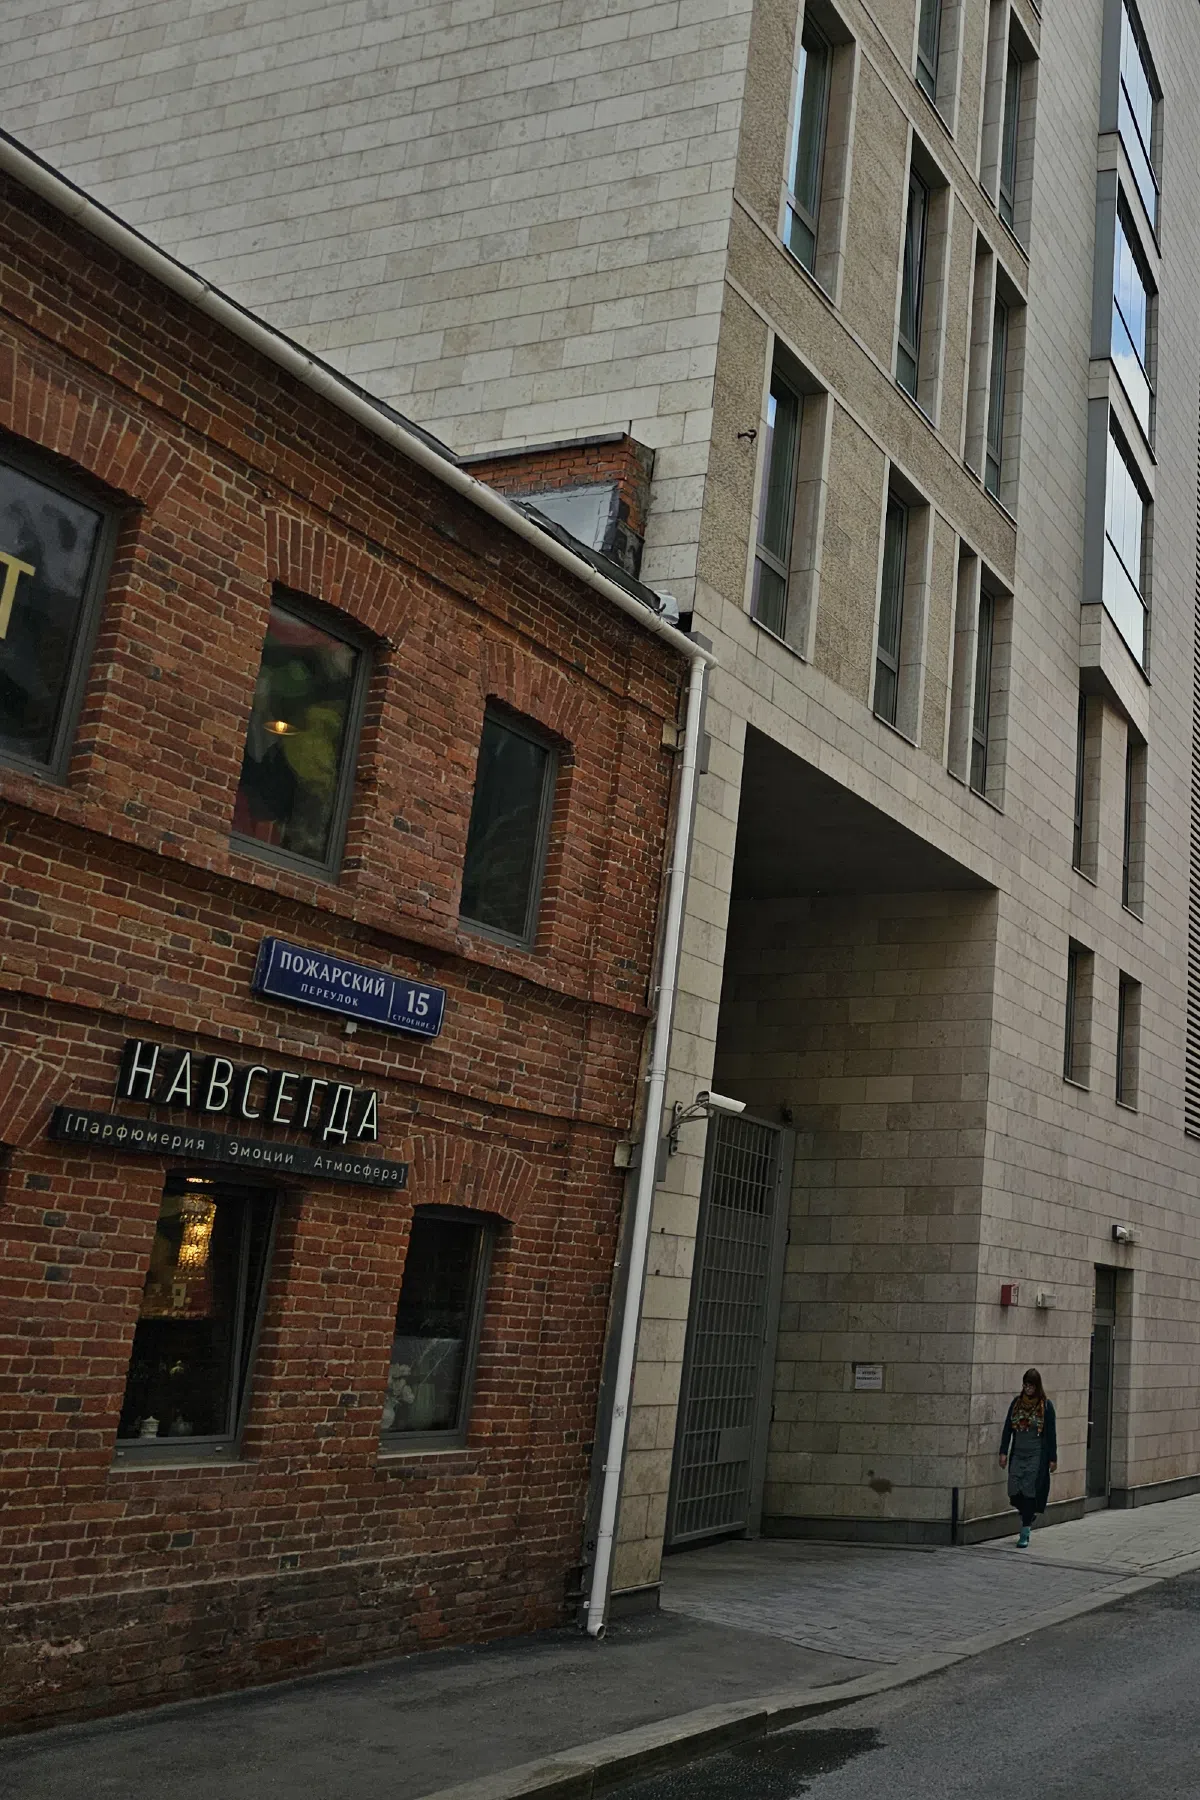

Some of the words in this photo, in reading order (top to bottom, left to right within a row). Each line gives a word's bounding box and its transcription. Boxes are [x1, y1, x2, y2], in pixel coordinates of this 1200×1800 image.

[279, 950, 386, 998] ПОЖАРСКИЙ
[300, 983, 359, 1007] ПЕРЕУЛОК
[407, 989, 430, 1015] 15
[392, 1013, 429, 1029] СТРОЕНИЕ
[431, 1023, 436, 1031] 2
[126, 1041, 378, 1144] НАВСЕГДА
[64, 1113, 206, 1150] [Парфюмерия
[228, 1141, 294, 1165] Эмоции
[313, 1155, 404, 1184] Атмосфера]
